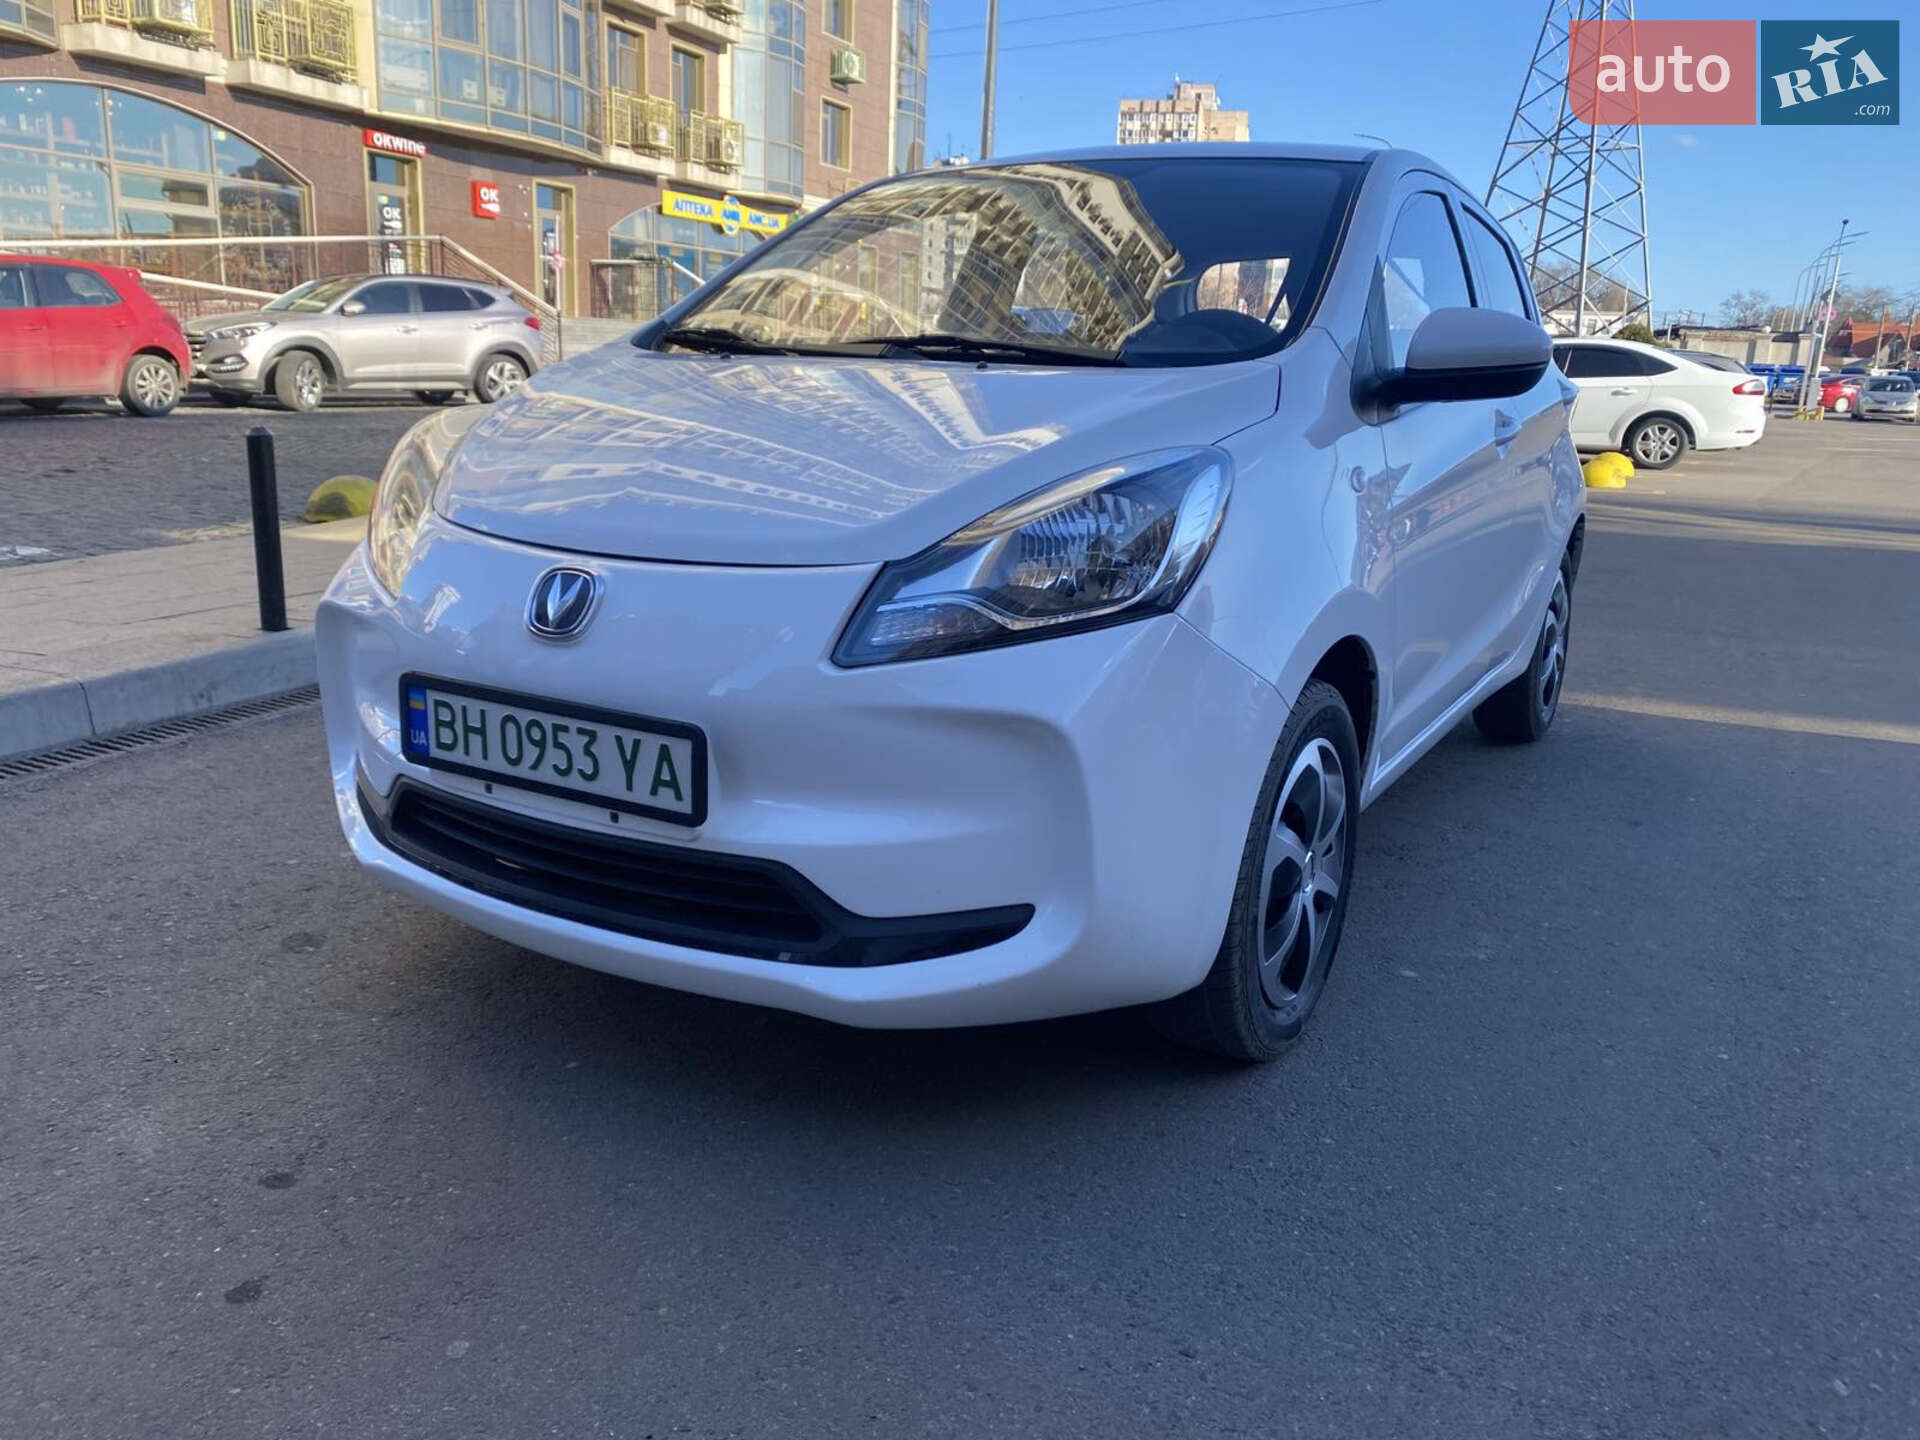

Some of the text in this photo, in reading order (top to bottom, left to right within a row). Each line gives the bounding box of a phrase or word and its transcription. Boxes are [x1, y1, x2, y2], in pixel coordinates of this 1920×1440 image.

[480, 186, 499, 202] OK
[383, 206, 402, 220] OK
[673, 197, 714, 217] АПТЕКА
[410, 729, 428, 746] UA
[433, 698, 683, 801] BH 0953 YA
